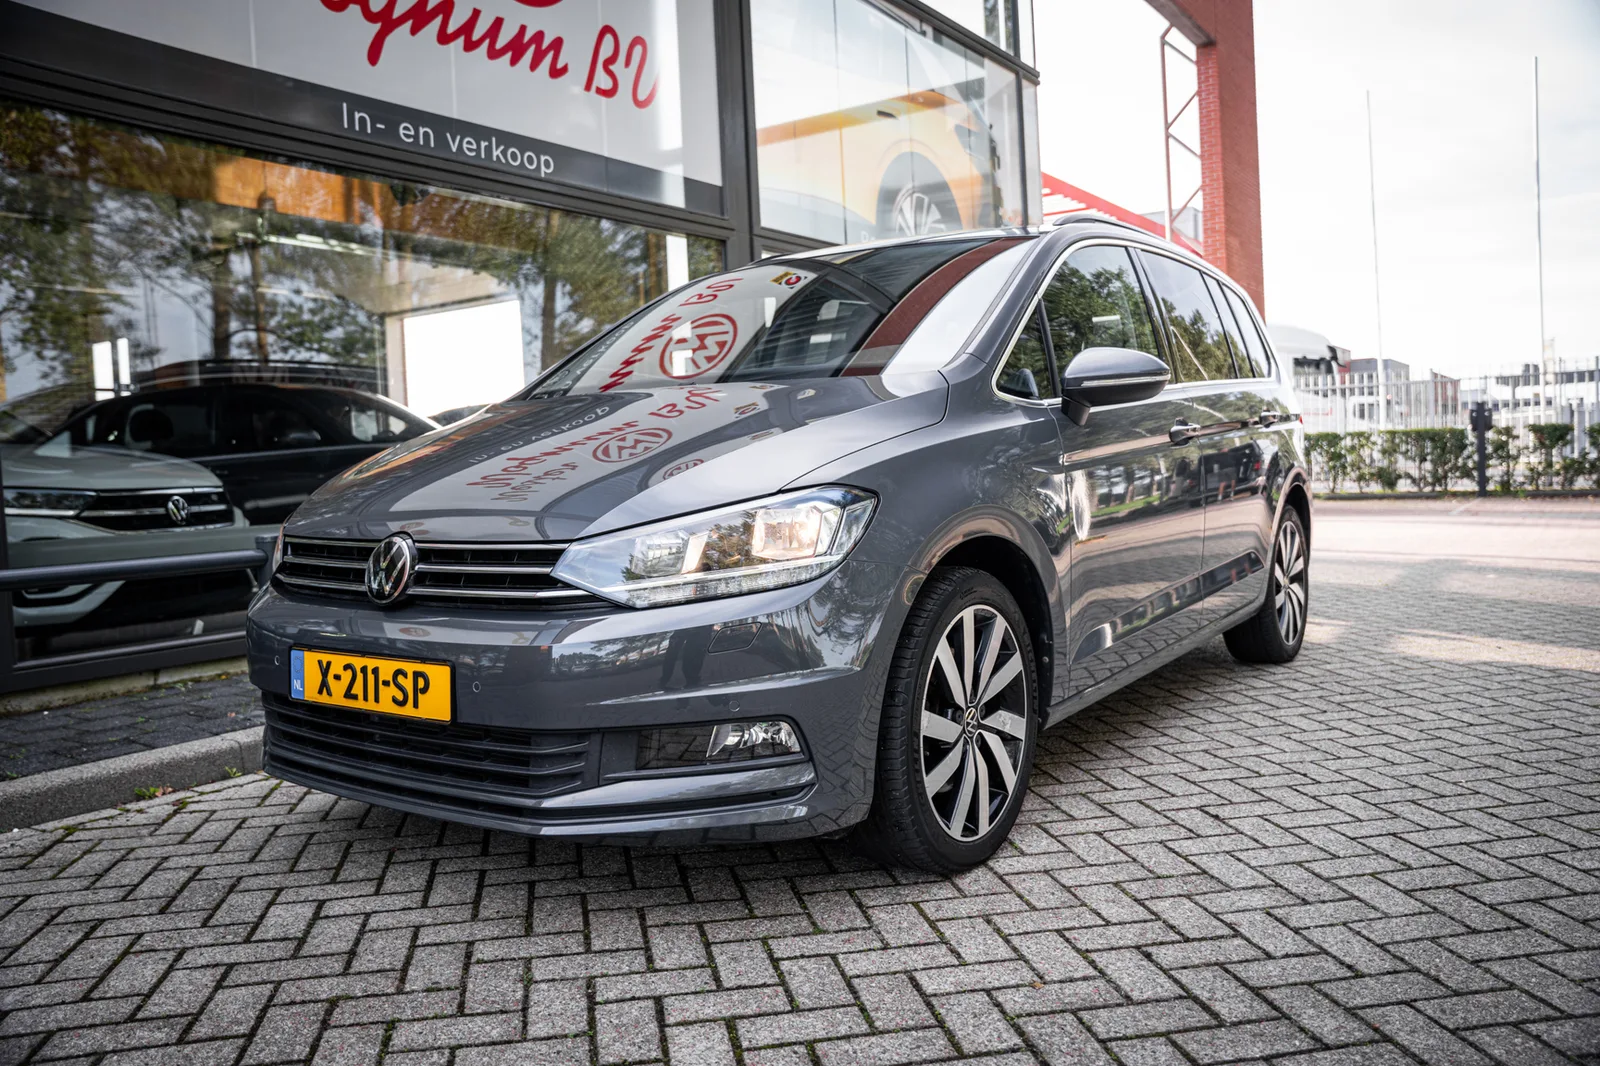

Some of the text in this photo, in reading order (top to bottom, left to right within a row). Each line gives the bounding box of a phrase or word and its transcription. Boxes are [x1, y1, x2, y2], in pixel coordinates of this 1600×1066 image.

[319, 0, 569, 80] gnum
[342, 102, 555, 178] In- en verkoop
[293, 679, 303, 691] NL
[317, 659, 431, 710] X-211-SP
